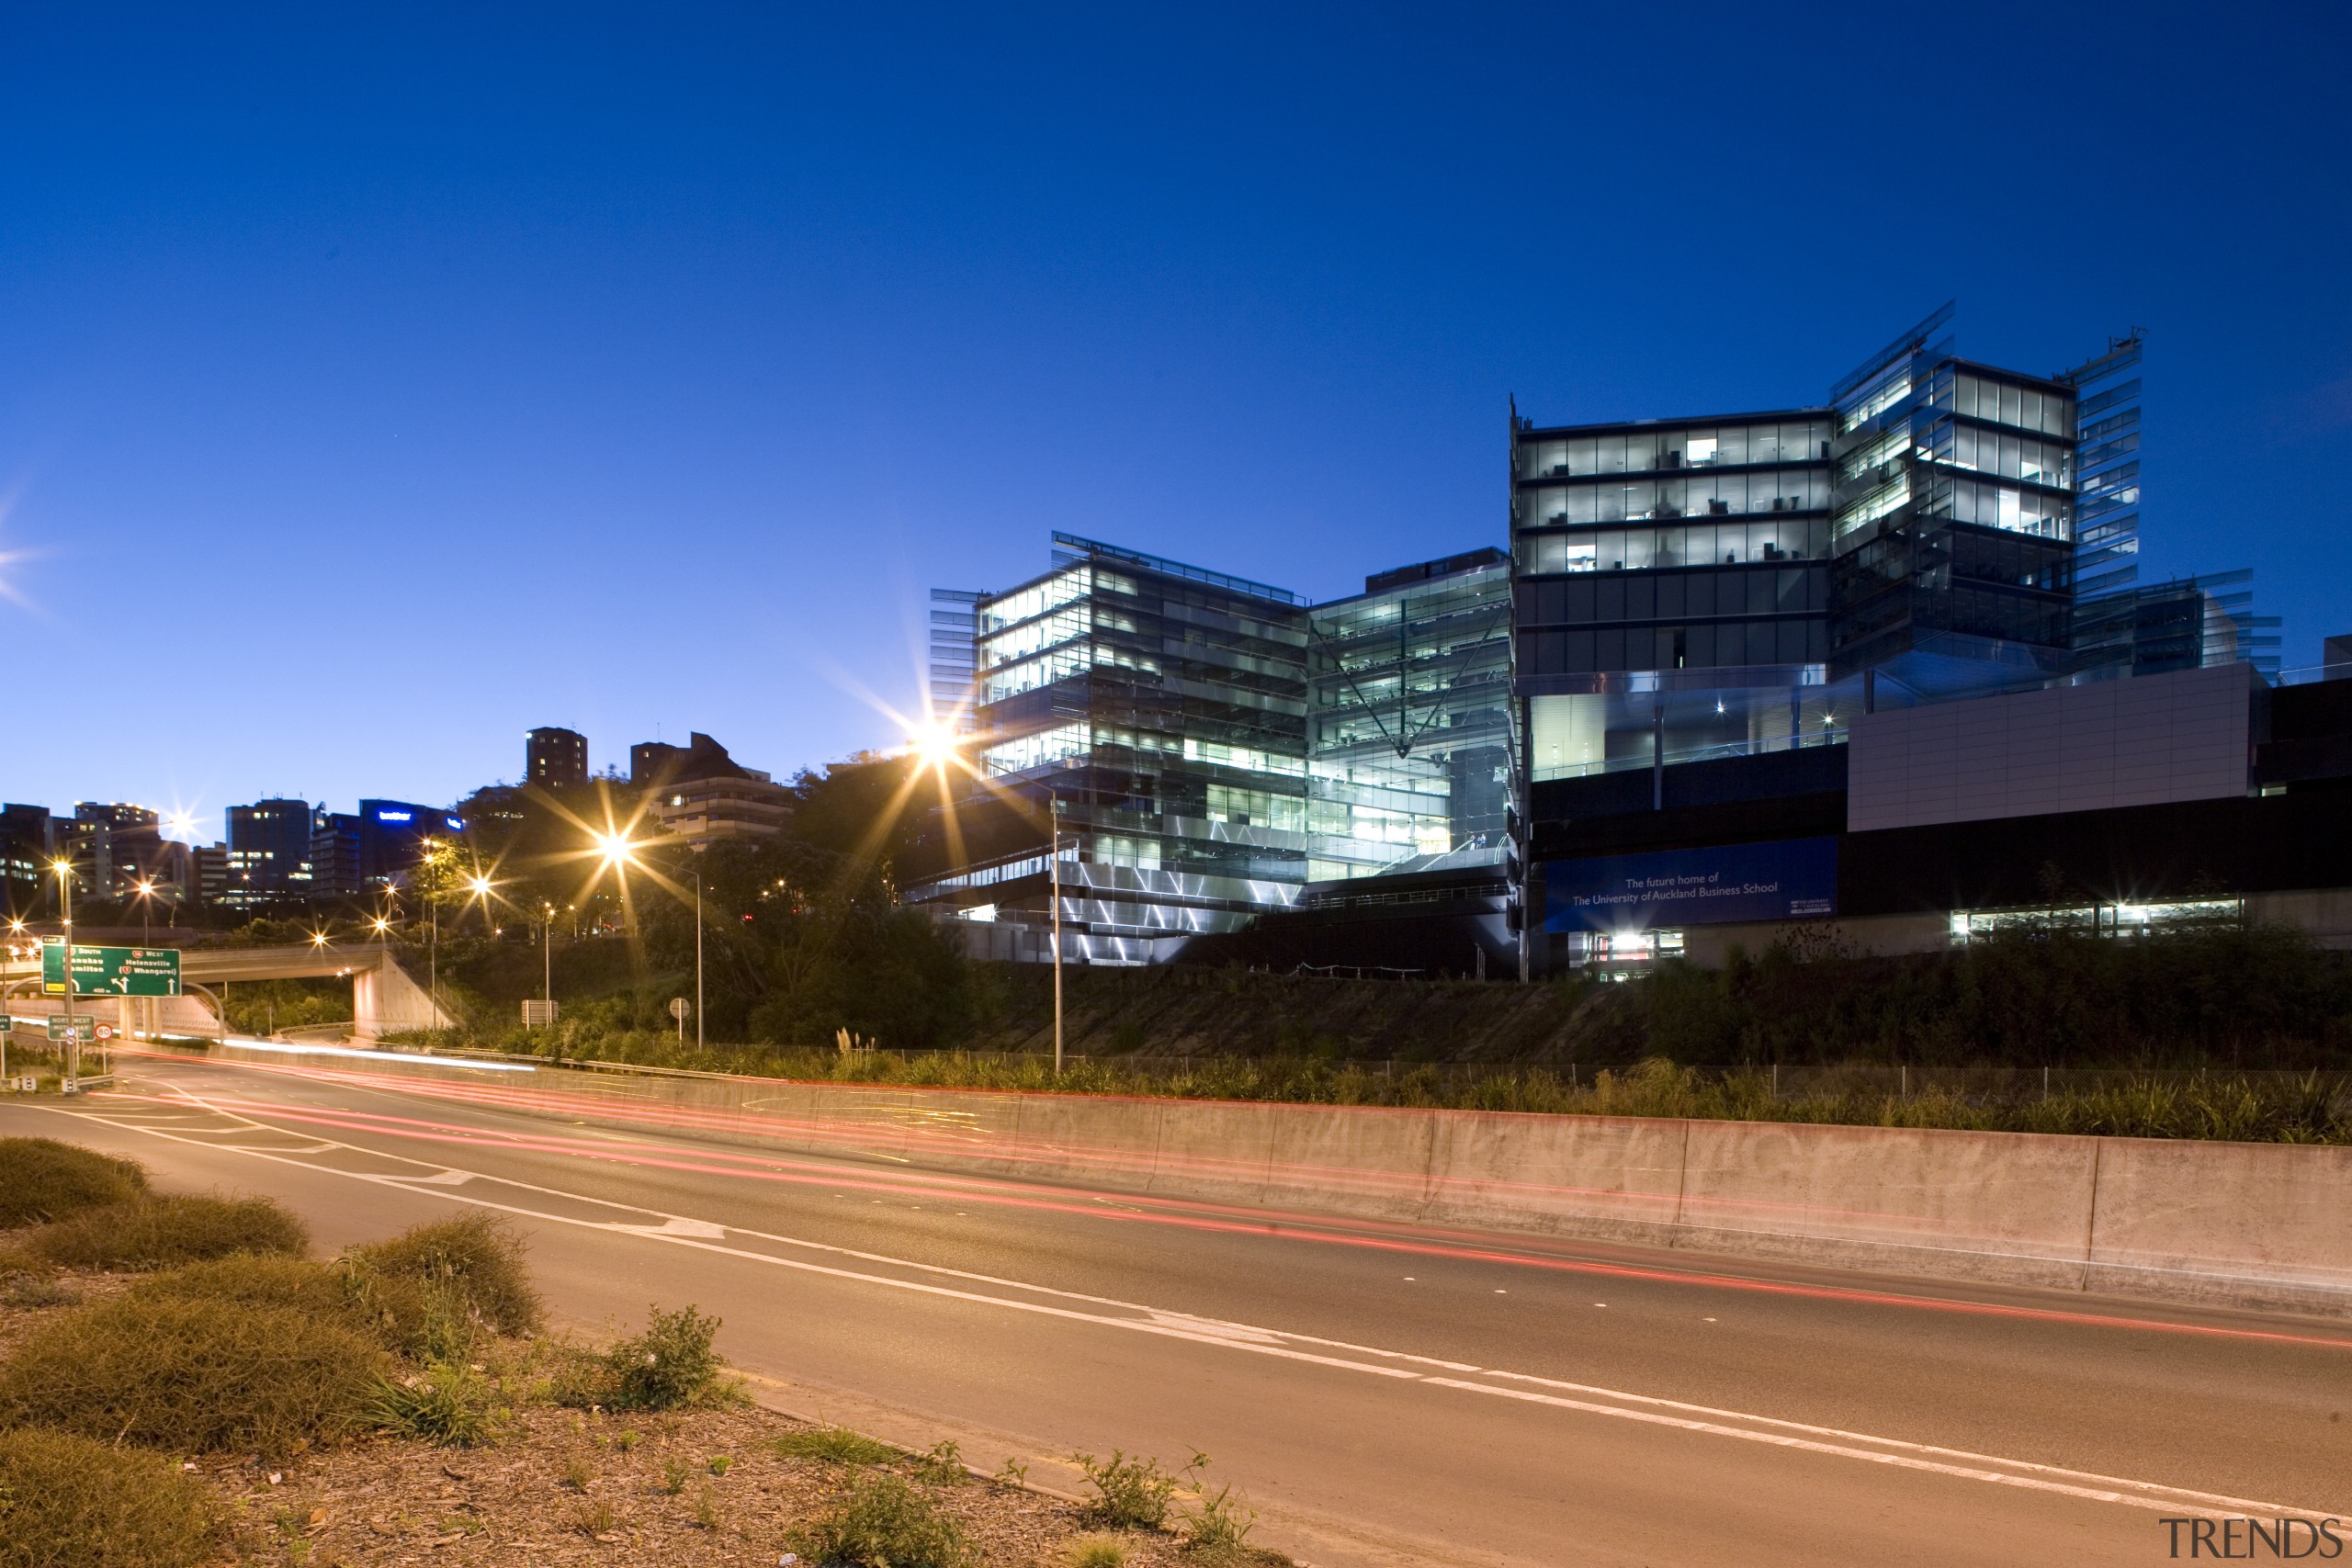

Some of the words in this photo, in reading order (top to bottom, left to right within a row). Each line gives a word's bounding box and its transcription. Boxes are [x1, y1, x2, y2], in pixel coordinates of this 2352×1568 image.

[1625, 879, 1644, 888] The
[1646, 877, 1675, 886] future
[1679, 875, 1705, 885] home
[1709, 872, 1719, 883] of
[1573, 897, 1590, 906] The
[1592, 893, 1638, 904] University
[1641, 891, 1652, 901] of
[1653, 887, 1696, 900] Auckland
[1699, 886, 1740, 897] Business
[1744, 882, 1778, 894] School
[125, 959, 171, 967] Helensville
[133, 967, 176, 976] Whangarei)
